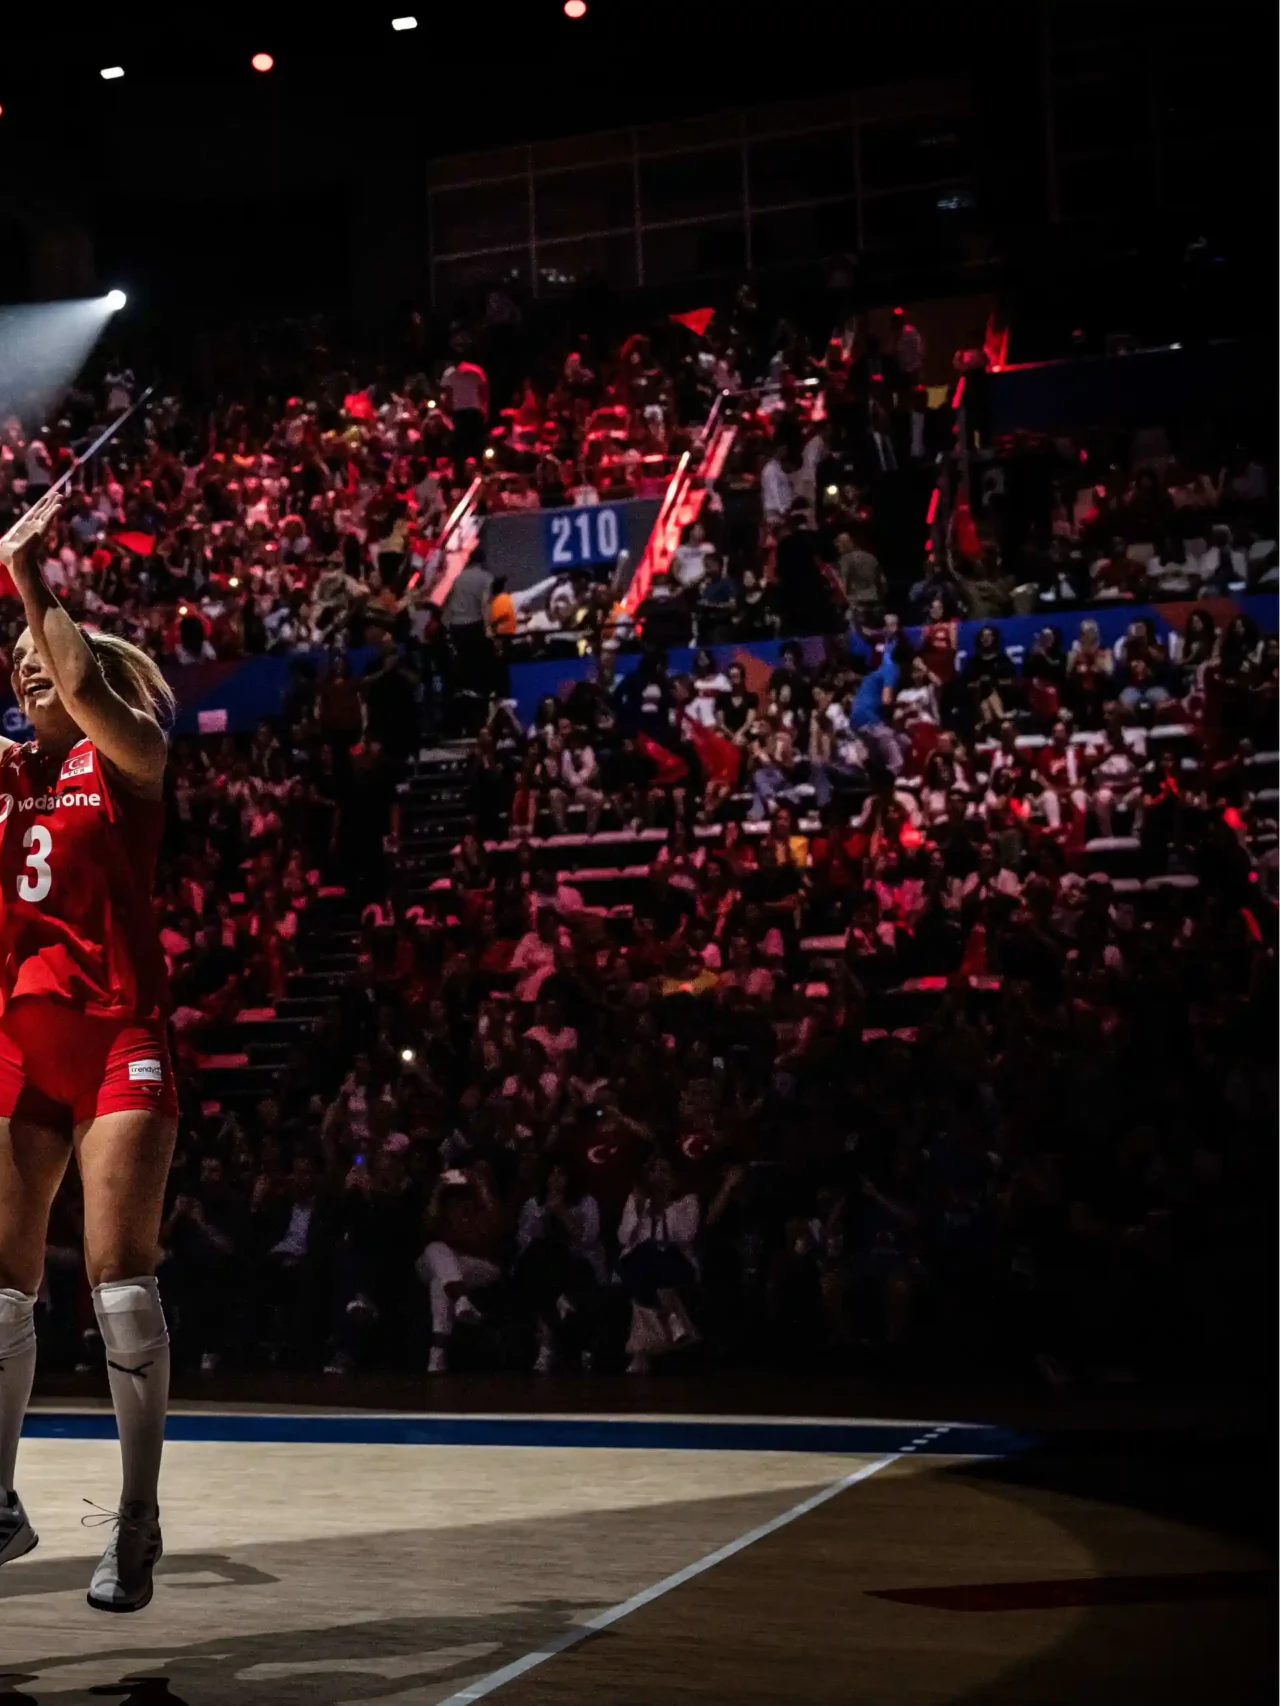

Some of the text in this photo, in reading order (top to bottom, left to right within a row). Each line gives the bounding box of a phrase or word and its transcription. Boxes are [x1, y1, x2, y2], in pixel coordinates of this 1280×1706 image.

[550, 508, 619, 563] 210
[17, 792, 102, 813] vodafone
[16, 824, 53, 903] 3
